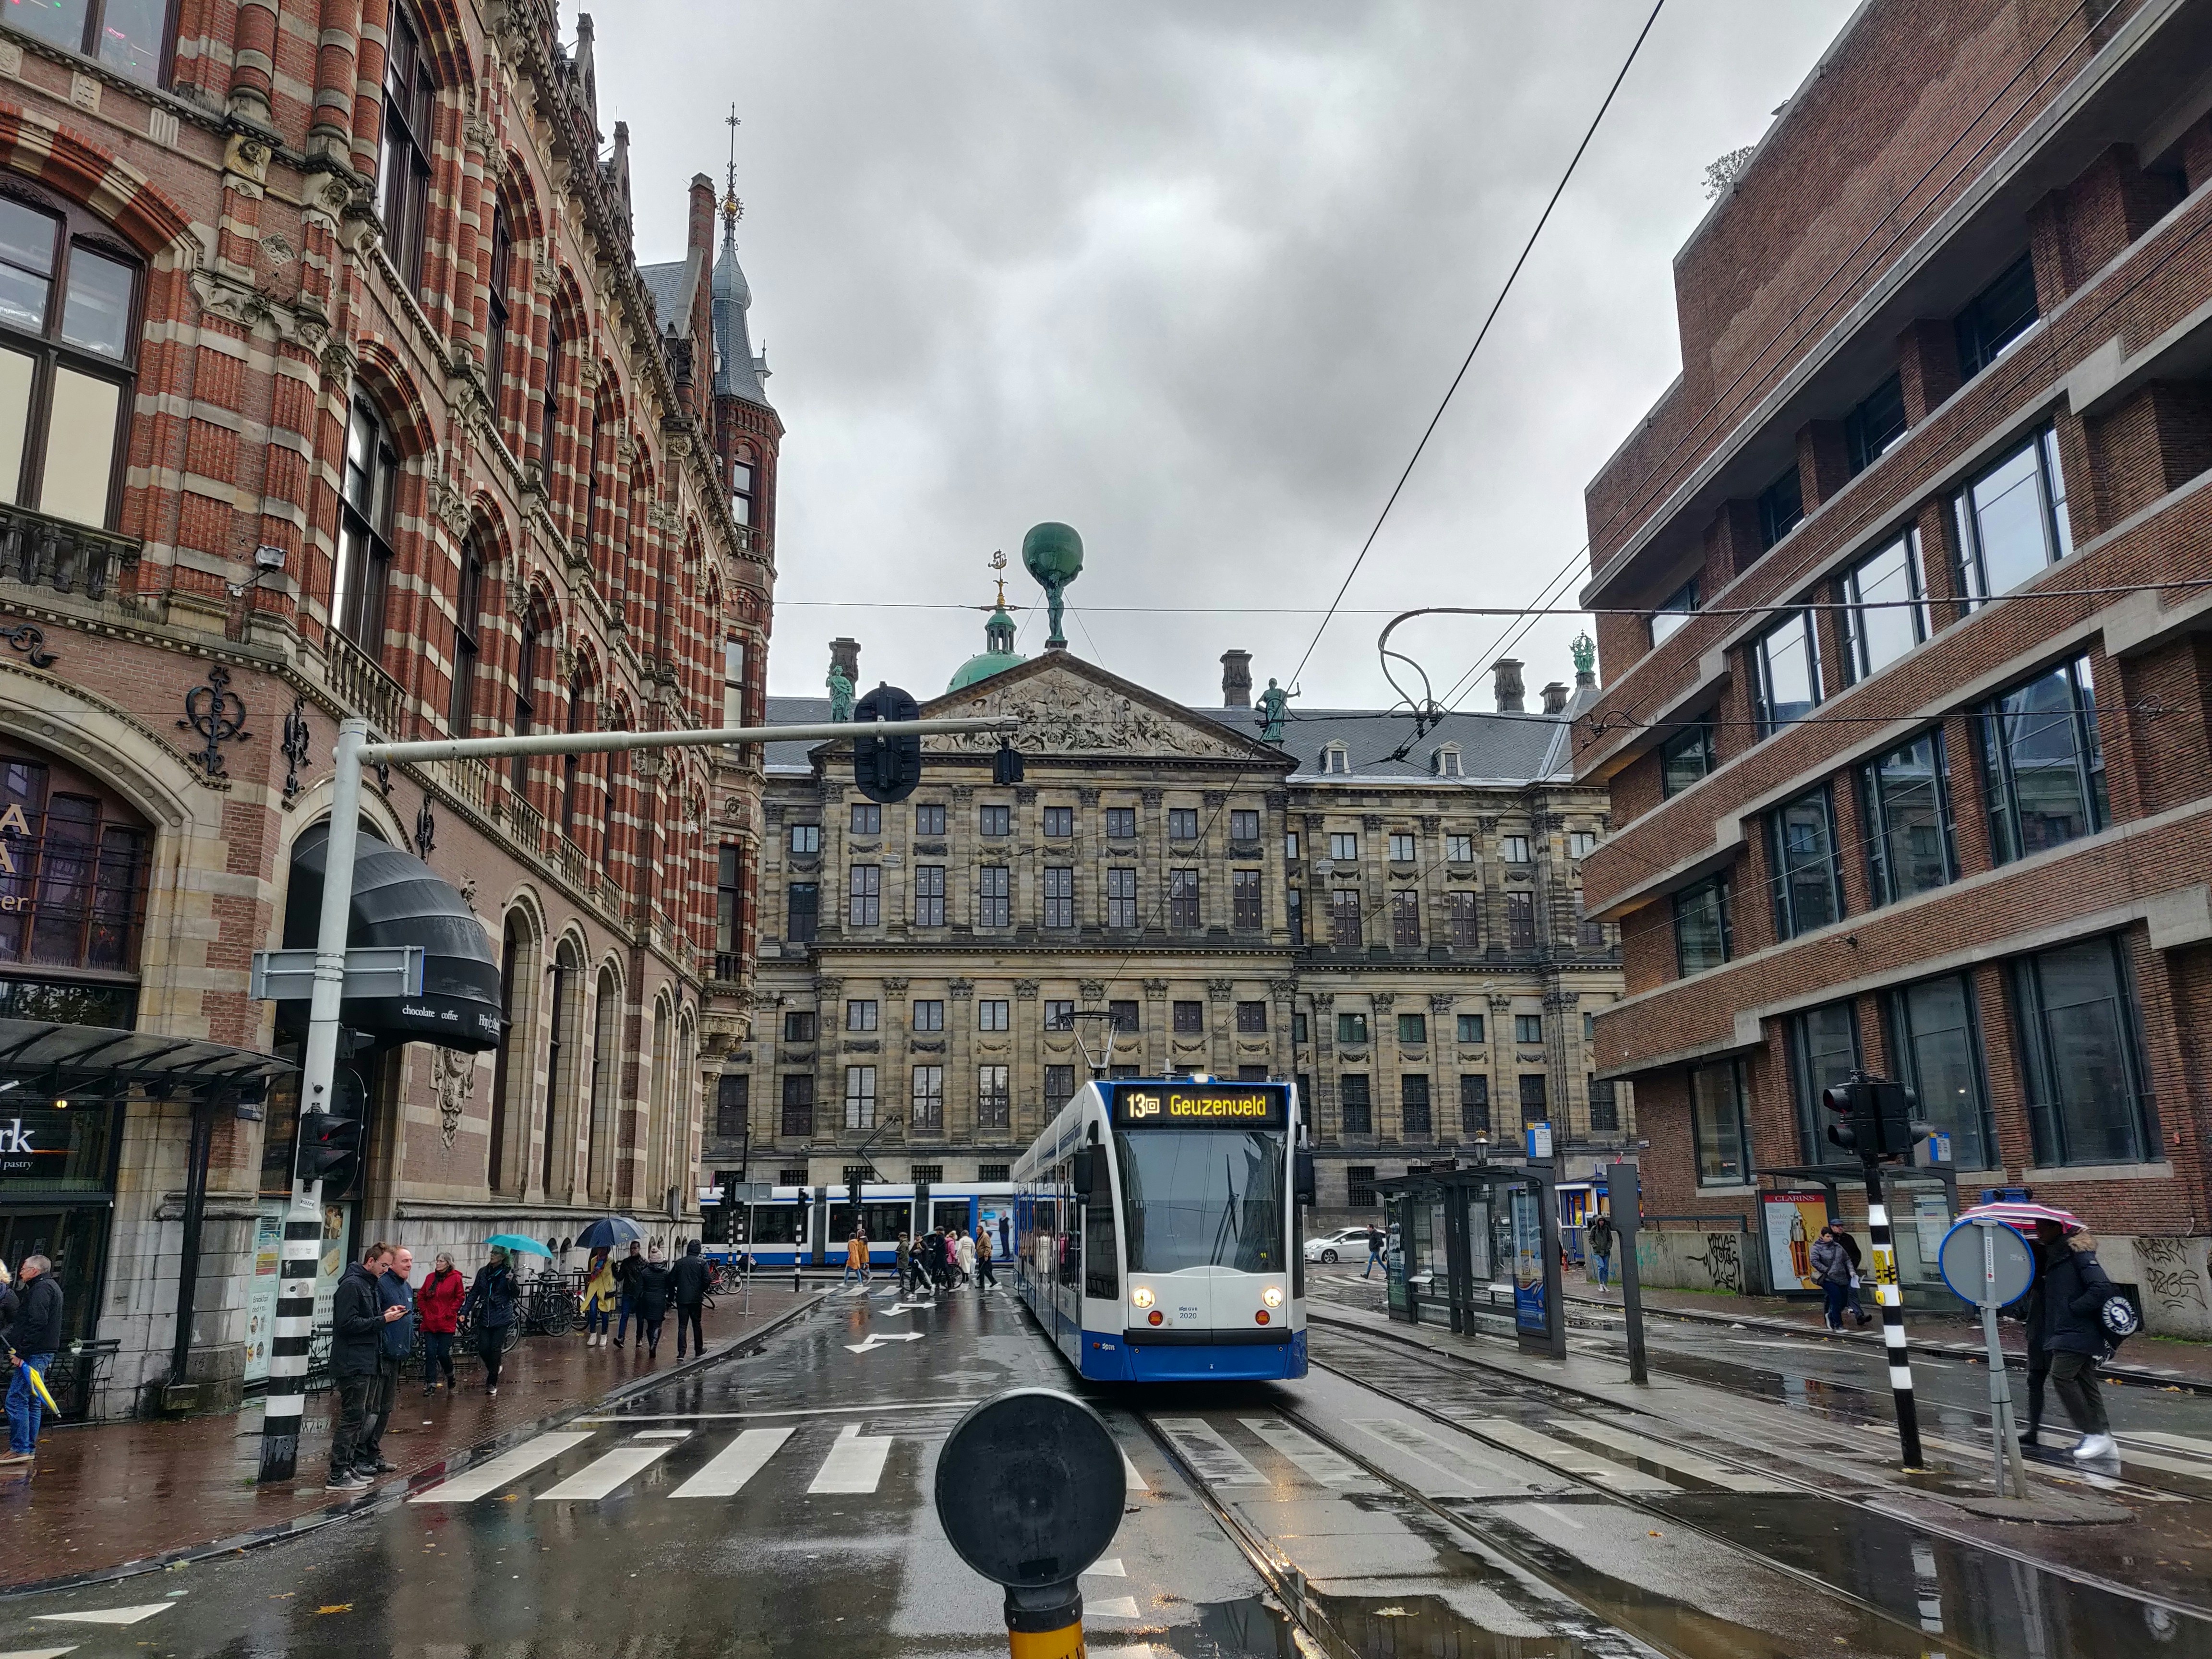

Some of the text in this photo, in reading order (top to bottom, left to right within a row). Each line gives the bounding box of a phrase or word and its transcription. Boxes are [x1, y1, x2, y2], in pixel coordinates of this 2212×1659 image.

[402, 1004, 435, 1018] chocolate
[441, 1010, 458, 1021] coffee
[1127, 1094, 1266, 1118] 13 Geuzenveld
[0, 1118, 35, 1152] rk
[3, 1161, 33, 1170] pastry
